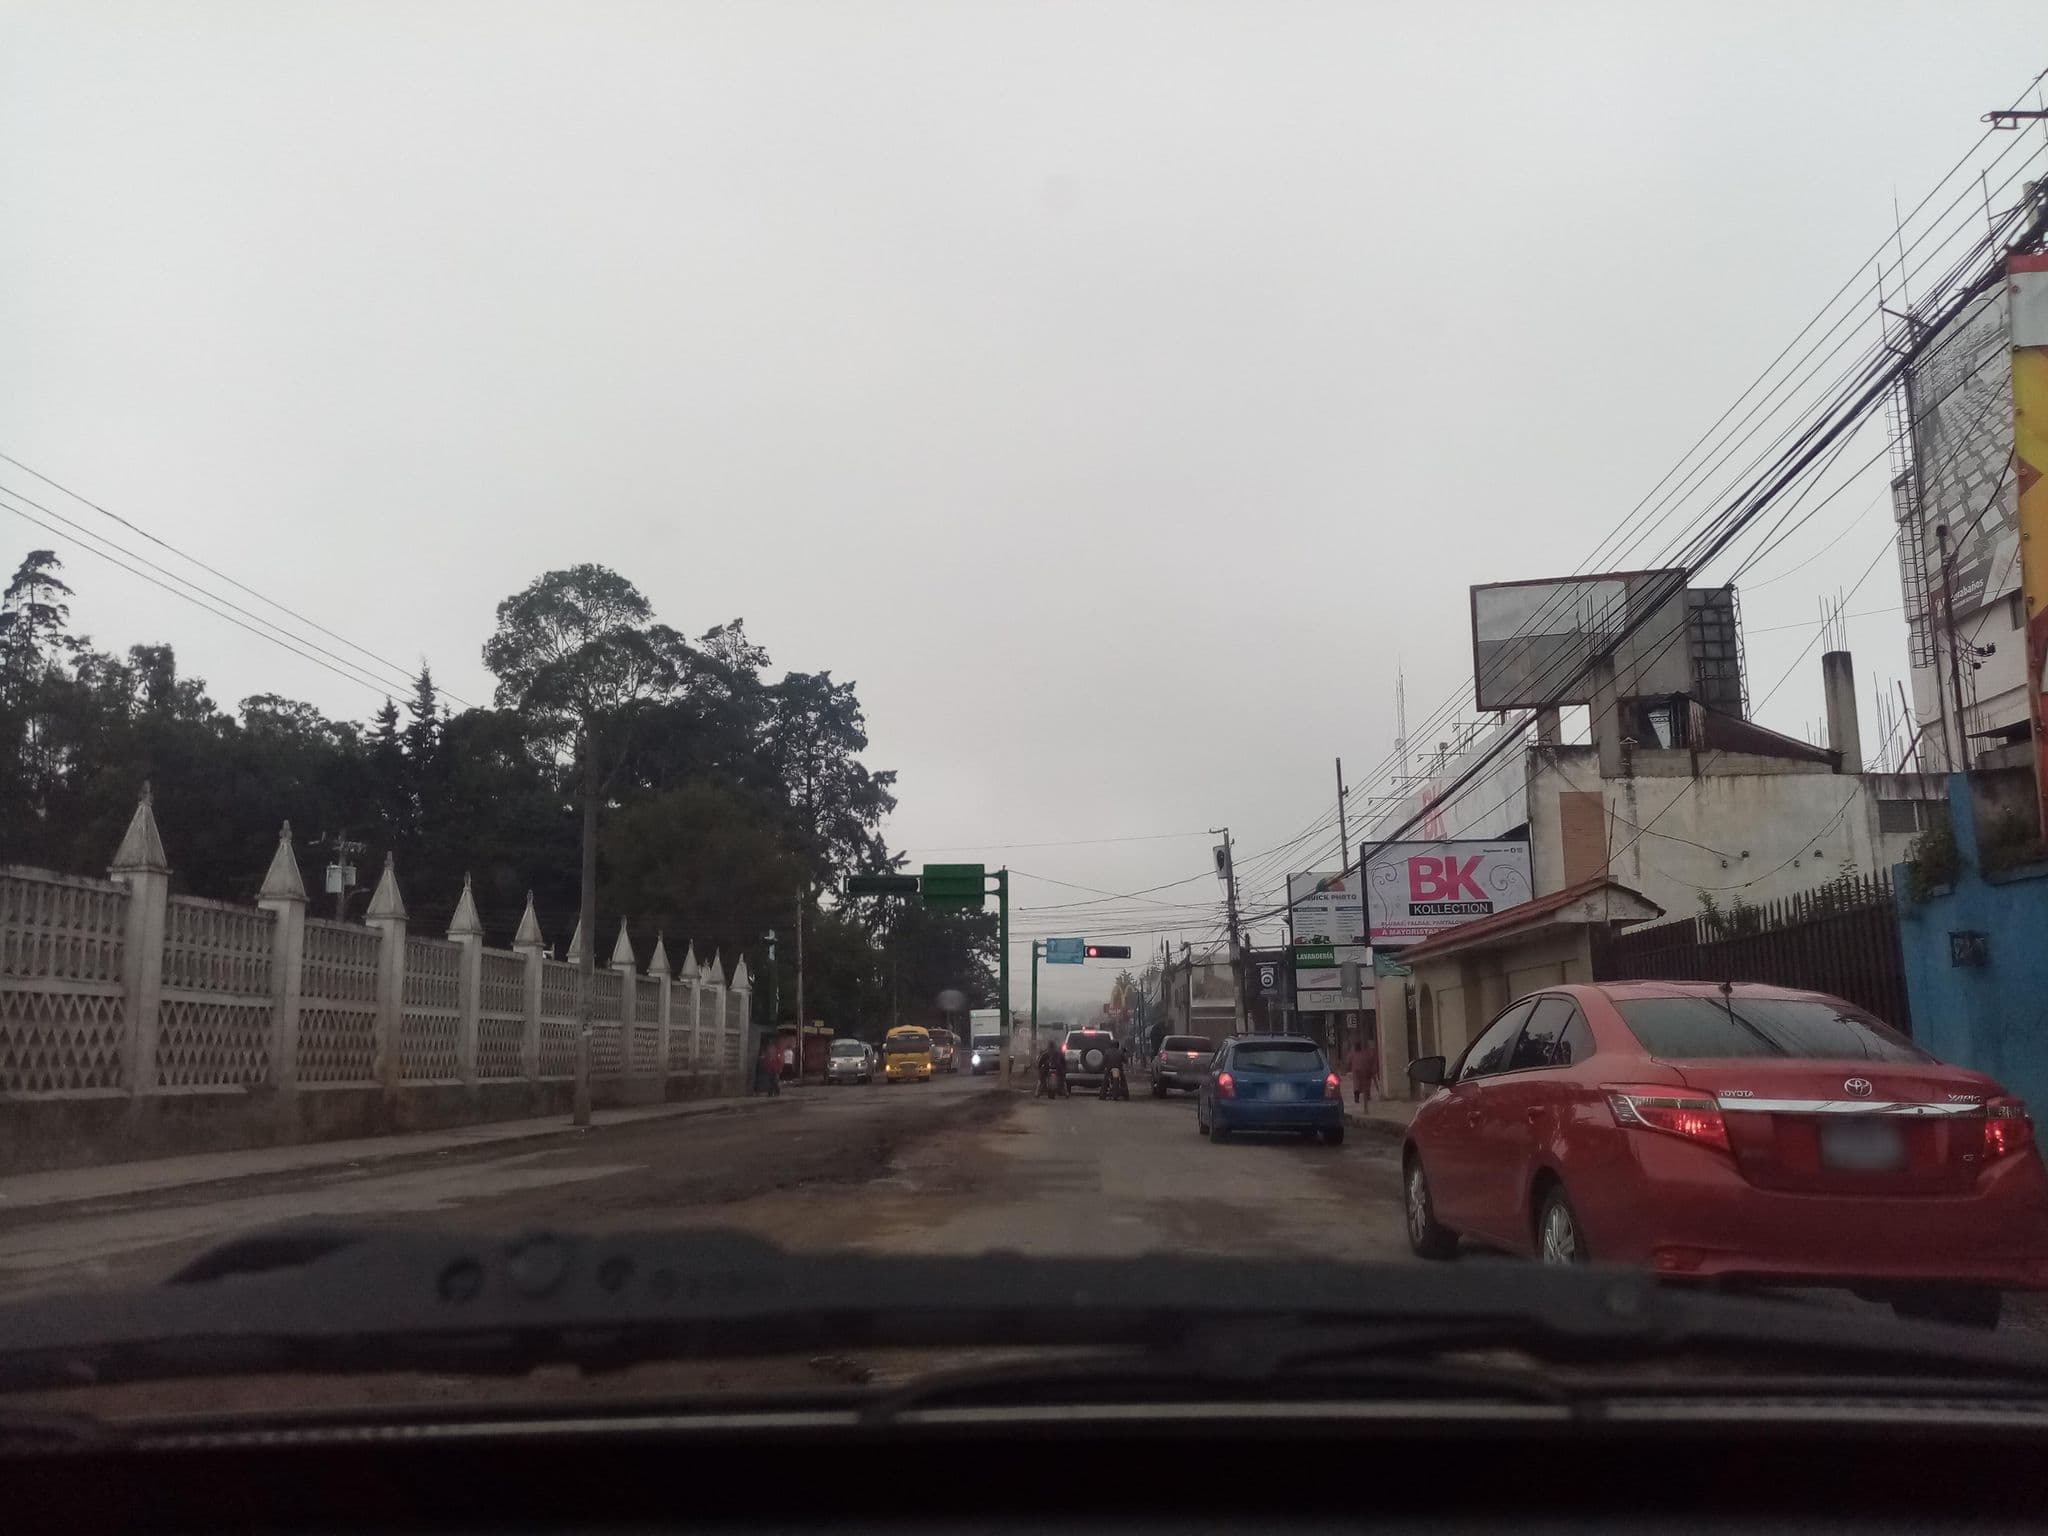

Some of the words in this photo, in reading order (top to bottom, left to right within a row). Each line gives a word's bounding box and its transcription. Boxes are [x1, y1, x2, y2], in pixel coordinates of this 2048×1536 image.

[1408, 856, 1489, 902] BK
[1414, 903, 1488, 915] KOLLECTION
[1296, 951, 1334, 960] LAVANDERÍA
[1719, 1089, 1755, 1098] TOYOTA
[1947, 1094, 1982, 1103] YARIS
